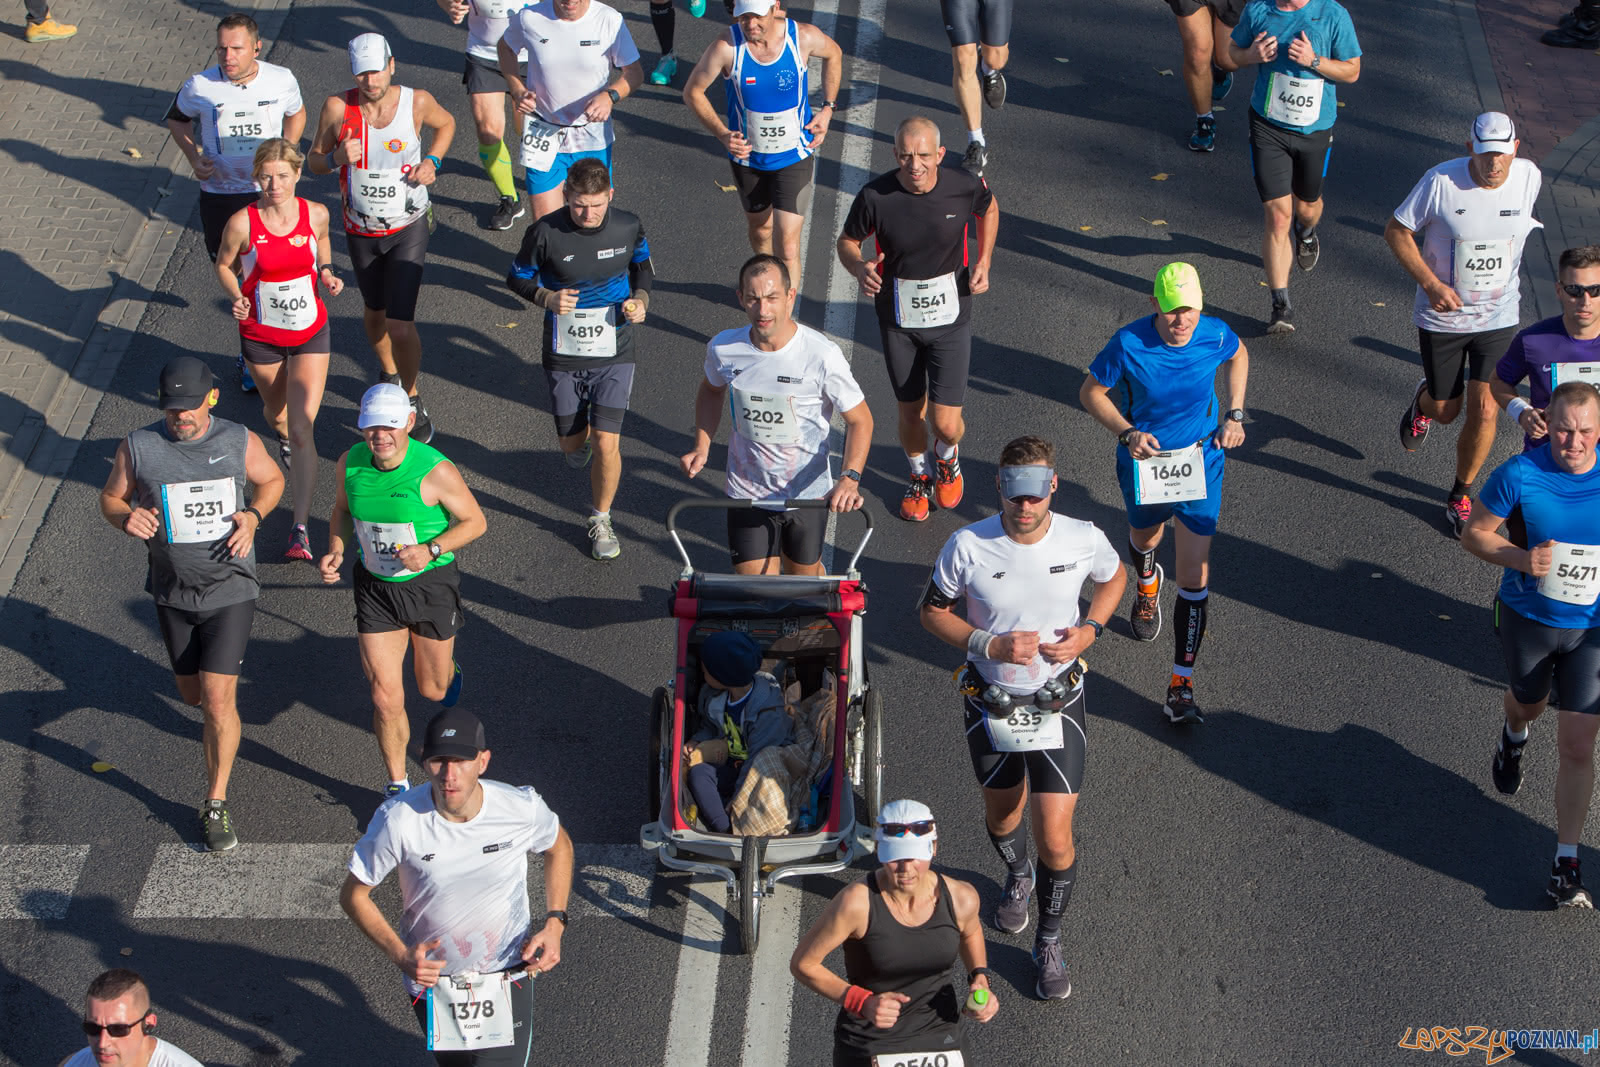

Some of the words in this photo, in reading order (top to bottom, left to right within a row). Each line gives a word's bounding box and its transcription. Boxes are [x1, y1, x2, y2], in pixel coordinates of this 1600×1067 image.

[1278, 91, 1314, 107] 4405
[229, 123, 262, 137] 3135
[760, 126, 786, 137] 335
[521, 133, 550, 152] 038
[360, 185, 396, 198] 3258
[563, 254, 575, 262] 4F
[1465, 257, 1502, 271] 4201
[269, 295, 307, 311] 3406
[911, 292, 946, 309] 5541
[568, 325, 604, 338] 4819
[743, 407, 784, 424] 2202
[1151, 463, 1192, 480] 1640
[184, 500, 224, 518] 5231
[992, 571, 1006, 579] 4F
[1557, 563, 1598, 581] 5471
[1007, 711, 1042, 726] 635
[421, 853, 435, 862] 4F
[448, 999, 495, 1020] 1378
[894, 1053, 949, 1067] 540
